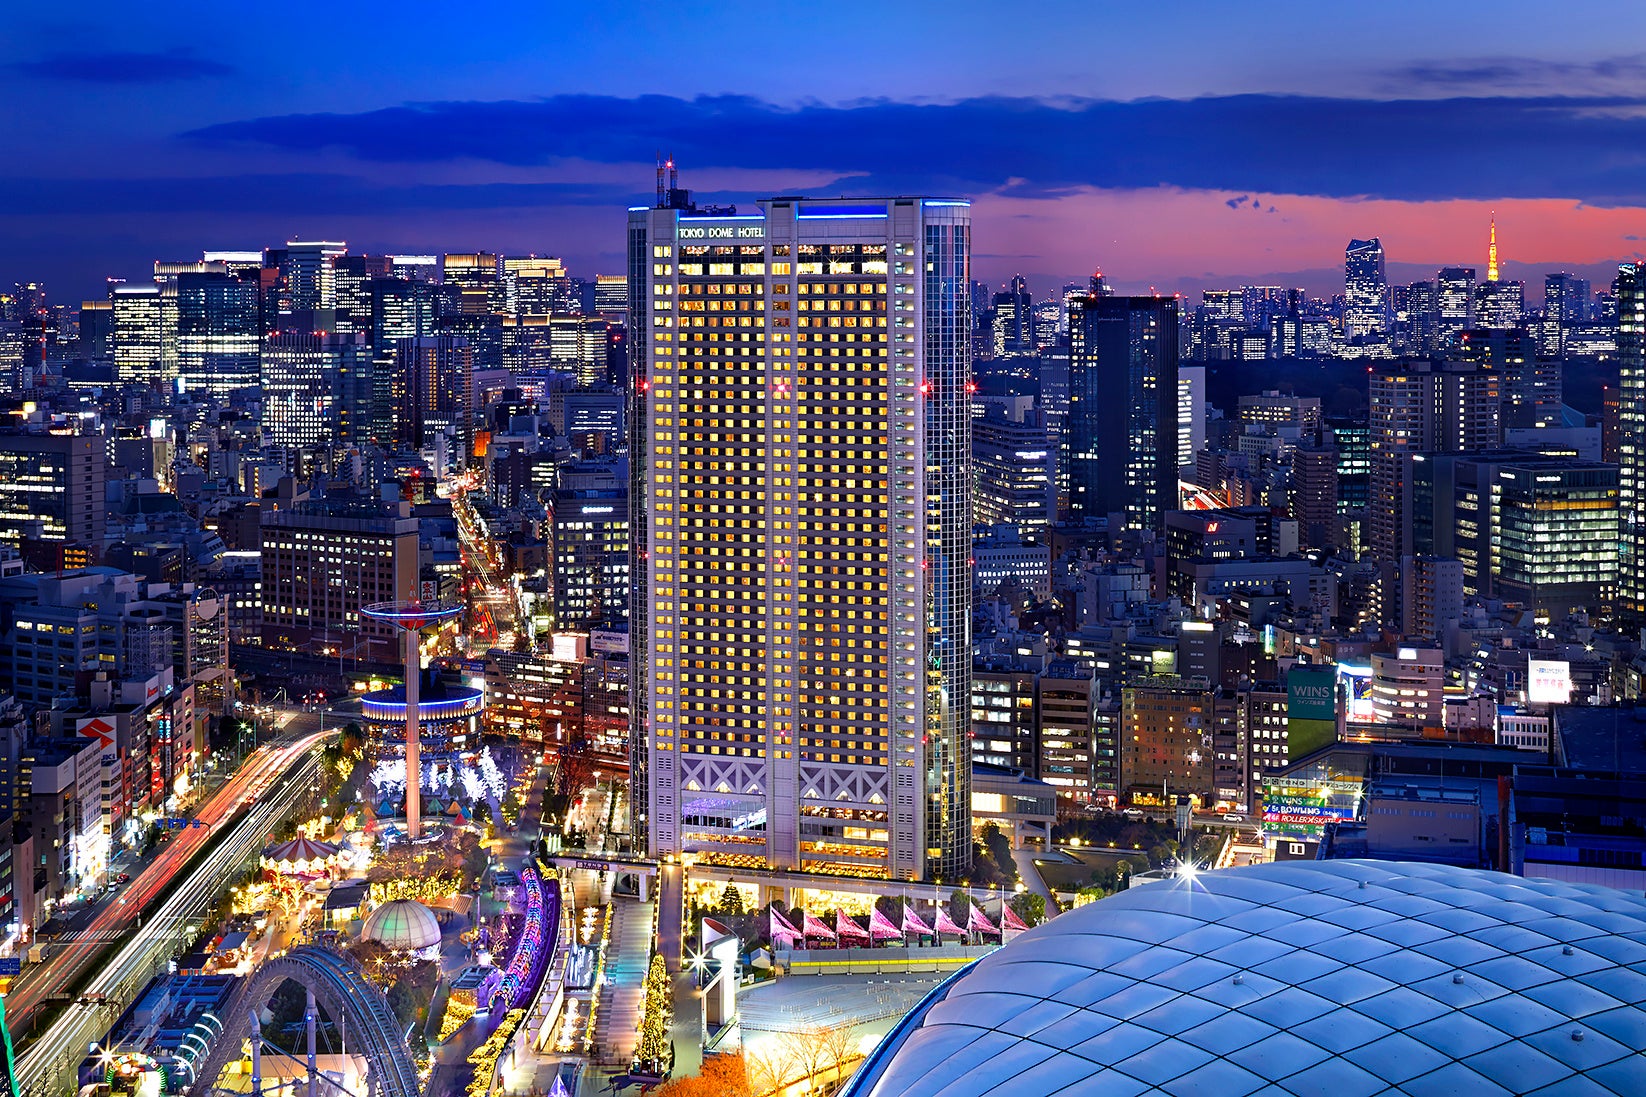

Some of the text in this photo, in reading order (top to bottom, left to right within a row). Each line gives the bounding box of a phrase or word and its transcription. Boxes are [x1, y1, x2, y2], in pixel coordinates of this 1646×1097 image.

[679, 227, 763, 238] TOKYO DOME HOTEL
[1293, 685, 1330, 698] WINS
[1281, 797, 1303, 805] WINS
[1281, 806, 1320, 816] BOWLING
